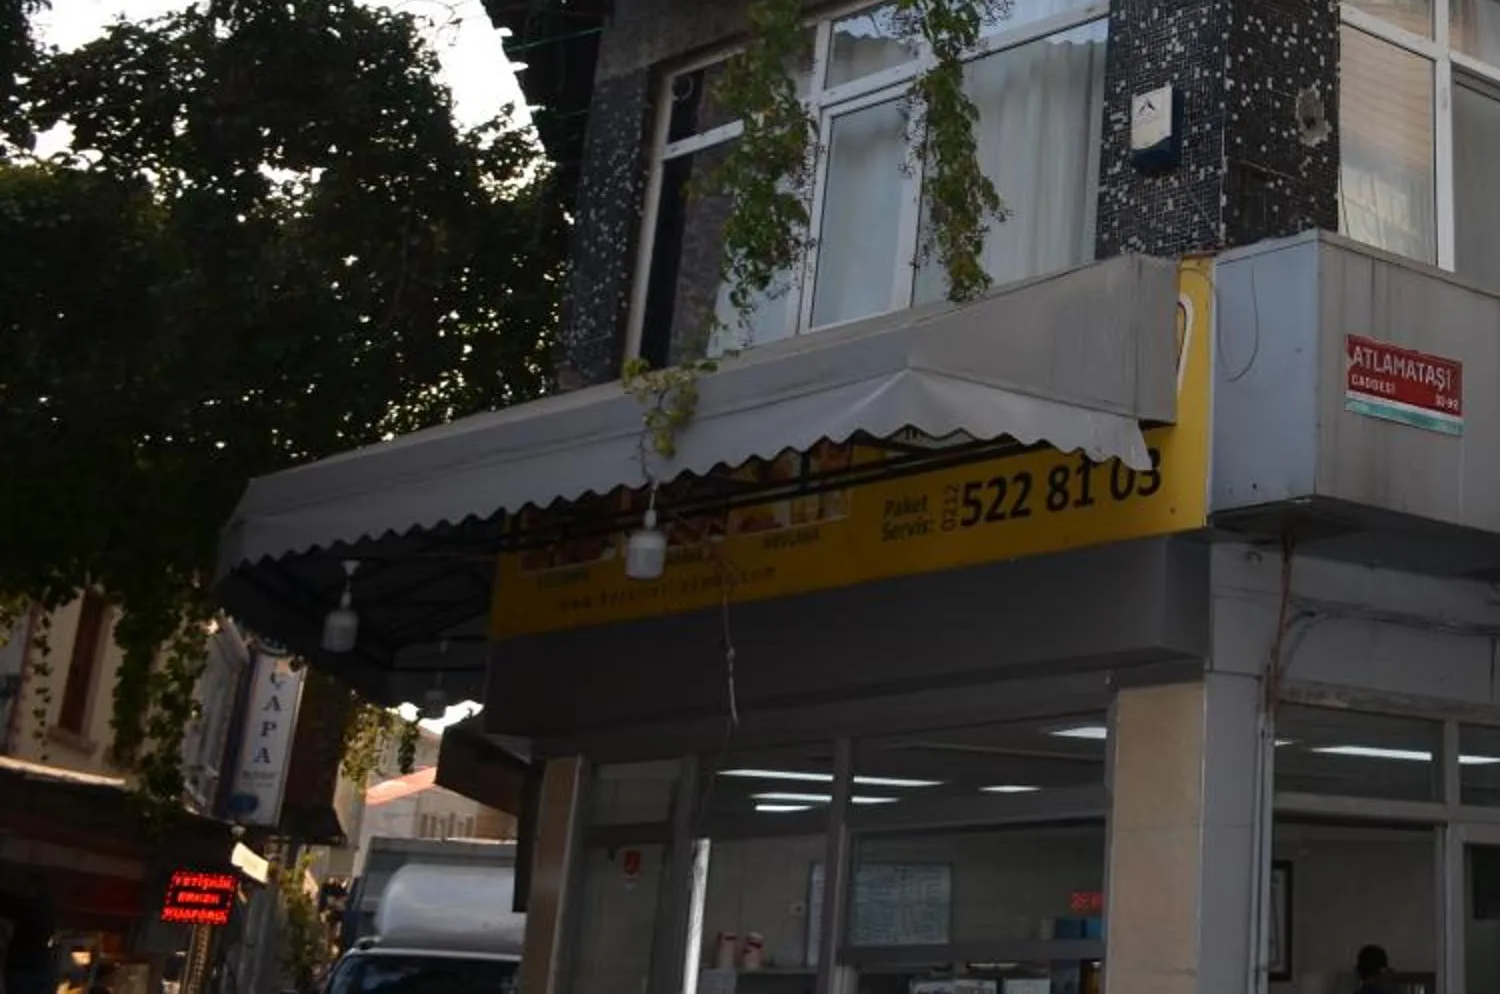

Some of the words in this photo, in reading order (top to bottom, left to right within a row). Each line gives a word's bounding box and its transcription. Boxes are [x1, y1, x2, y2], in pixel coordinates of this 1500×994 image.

[1353, 345, 1451, 392] ATLAMATAŞI
[960, 472, 1031, 526] 522
[1046, 451, 1094, 511] 81
